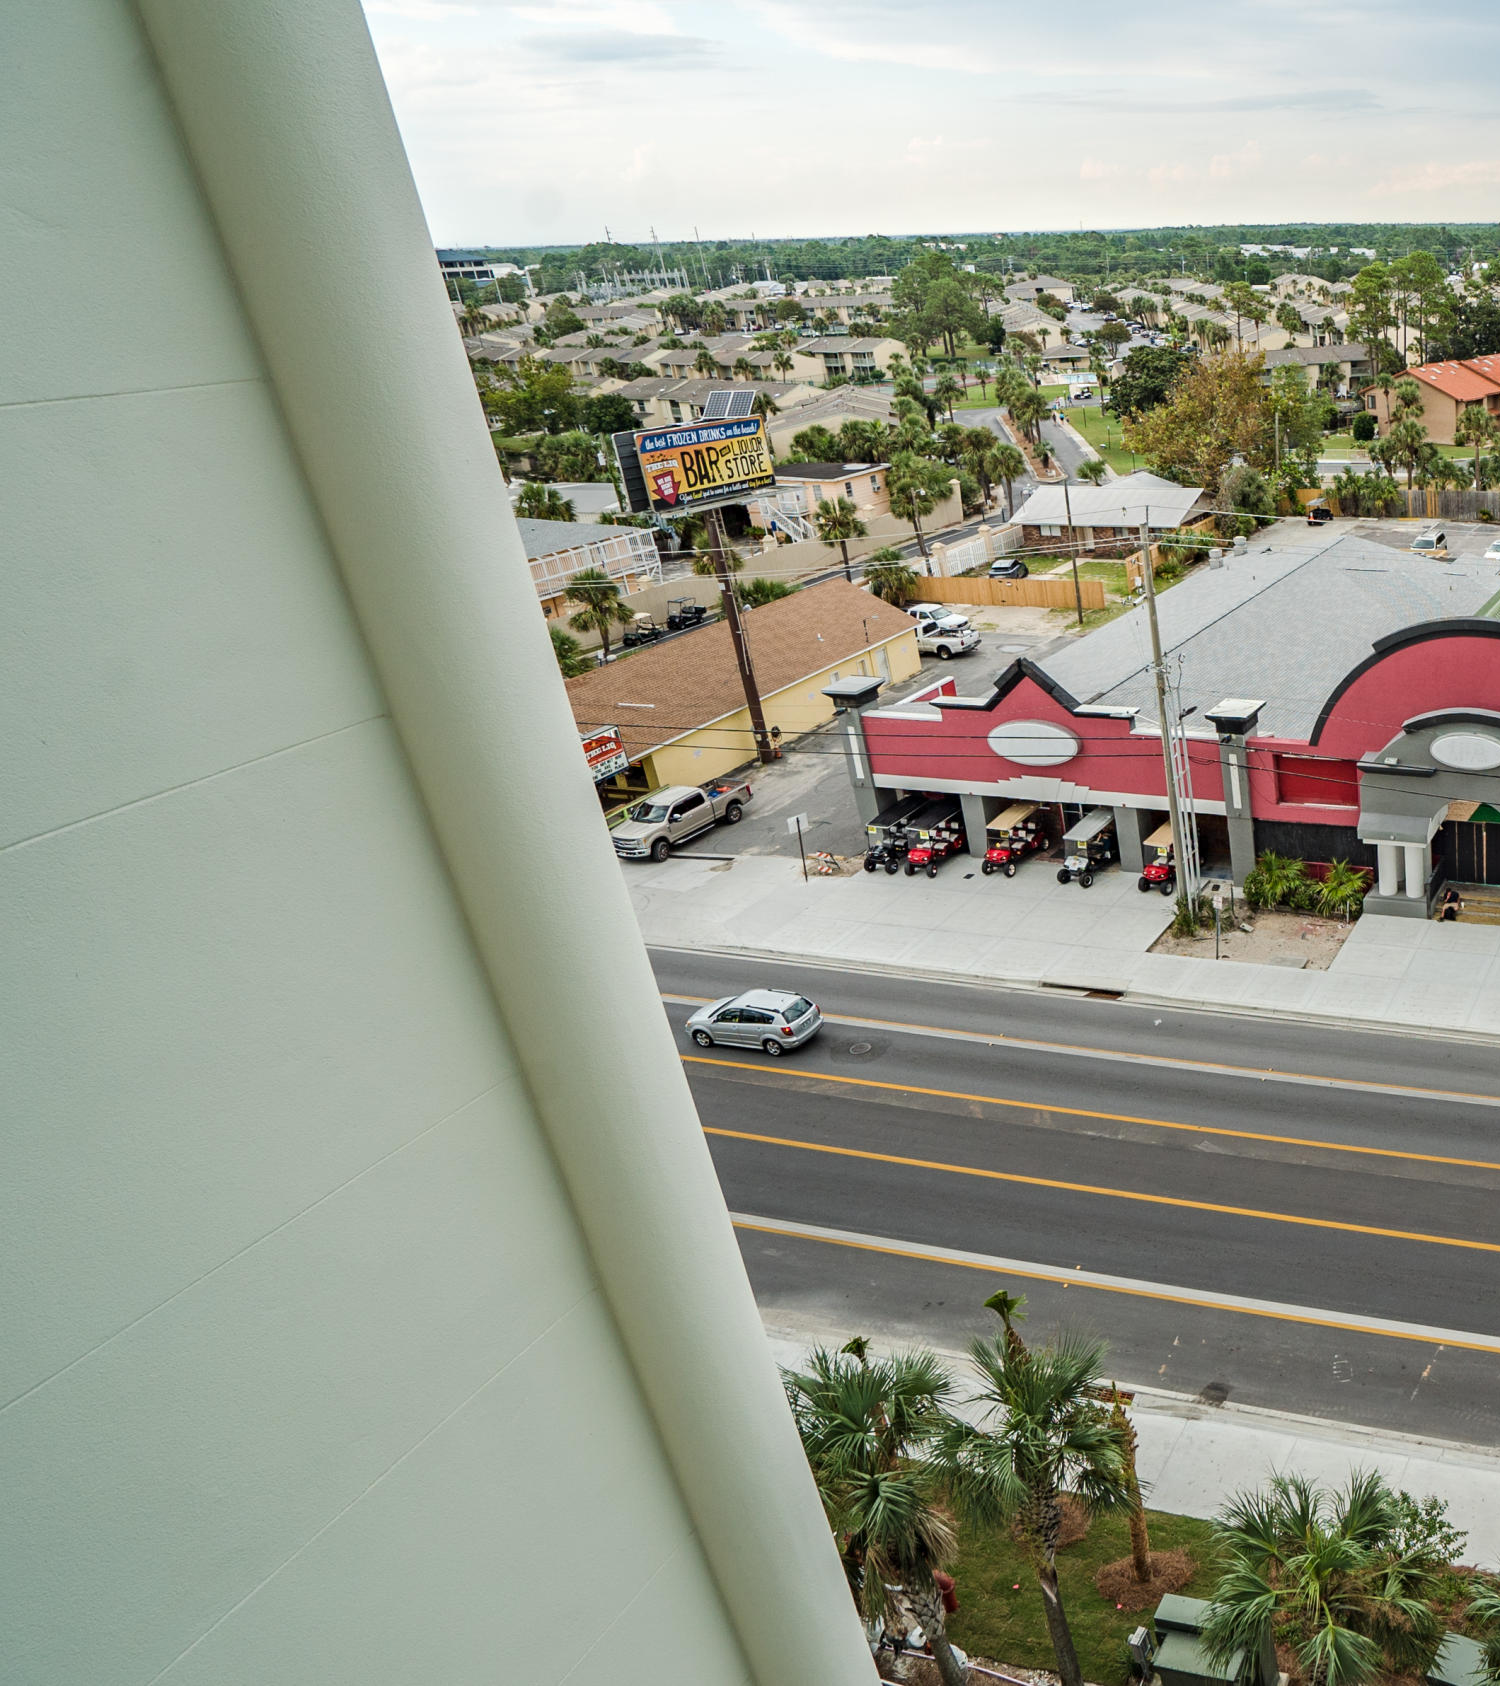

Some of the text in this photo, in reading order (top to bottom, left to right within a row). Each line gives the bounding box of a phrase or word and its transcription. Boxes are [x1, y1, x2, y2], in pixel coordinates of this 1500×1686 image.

[666, 431, 698, 447] FROZEN
[698, 427, 726, 442] DRINKS
[680, 446, 725, 489] BAR
[730, 436, 764, 457] LIQUOR
[725, 452, 768, 479] STORE
